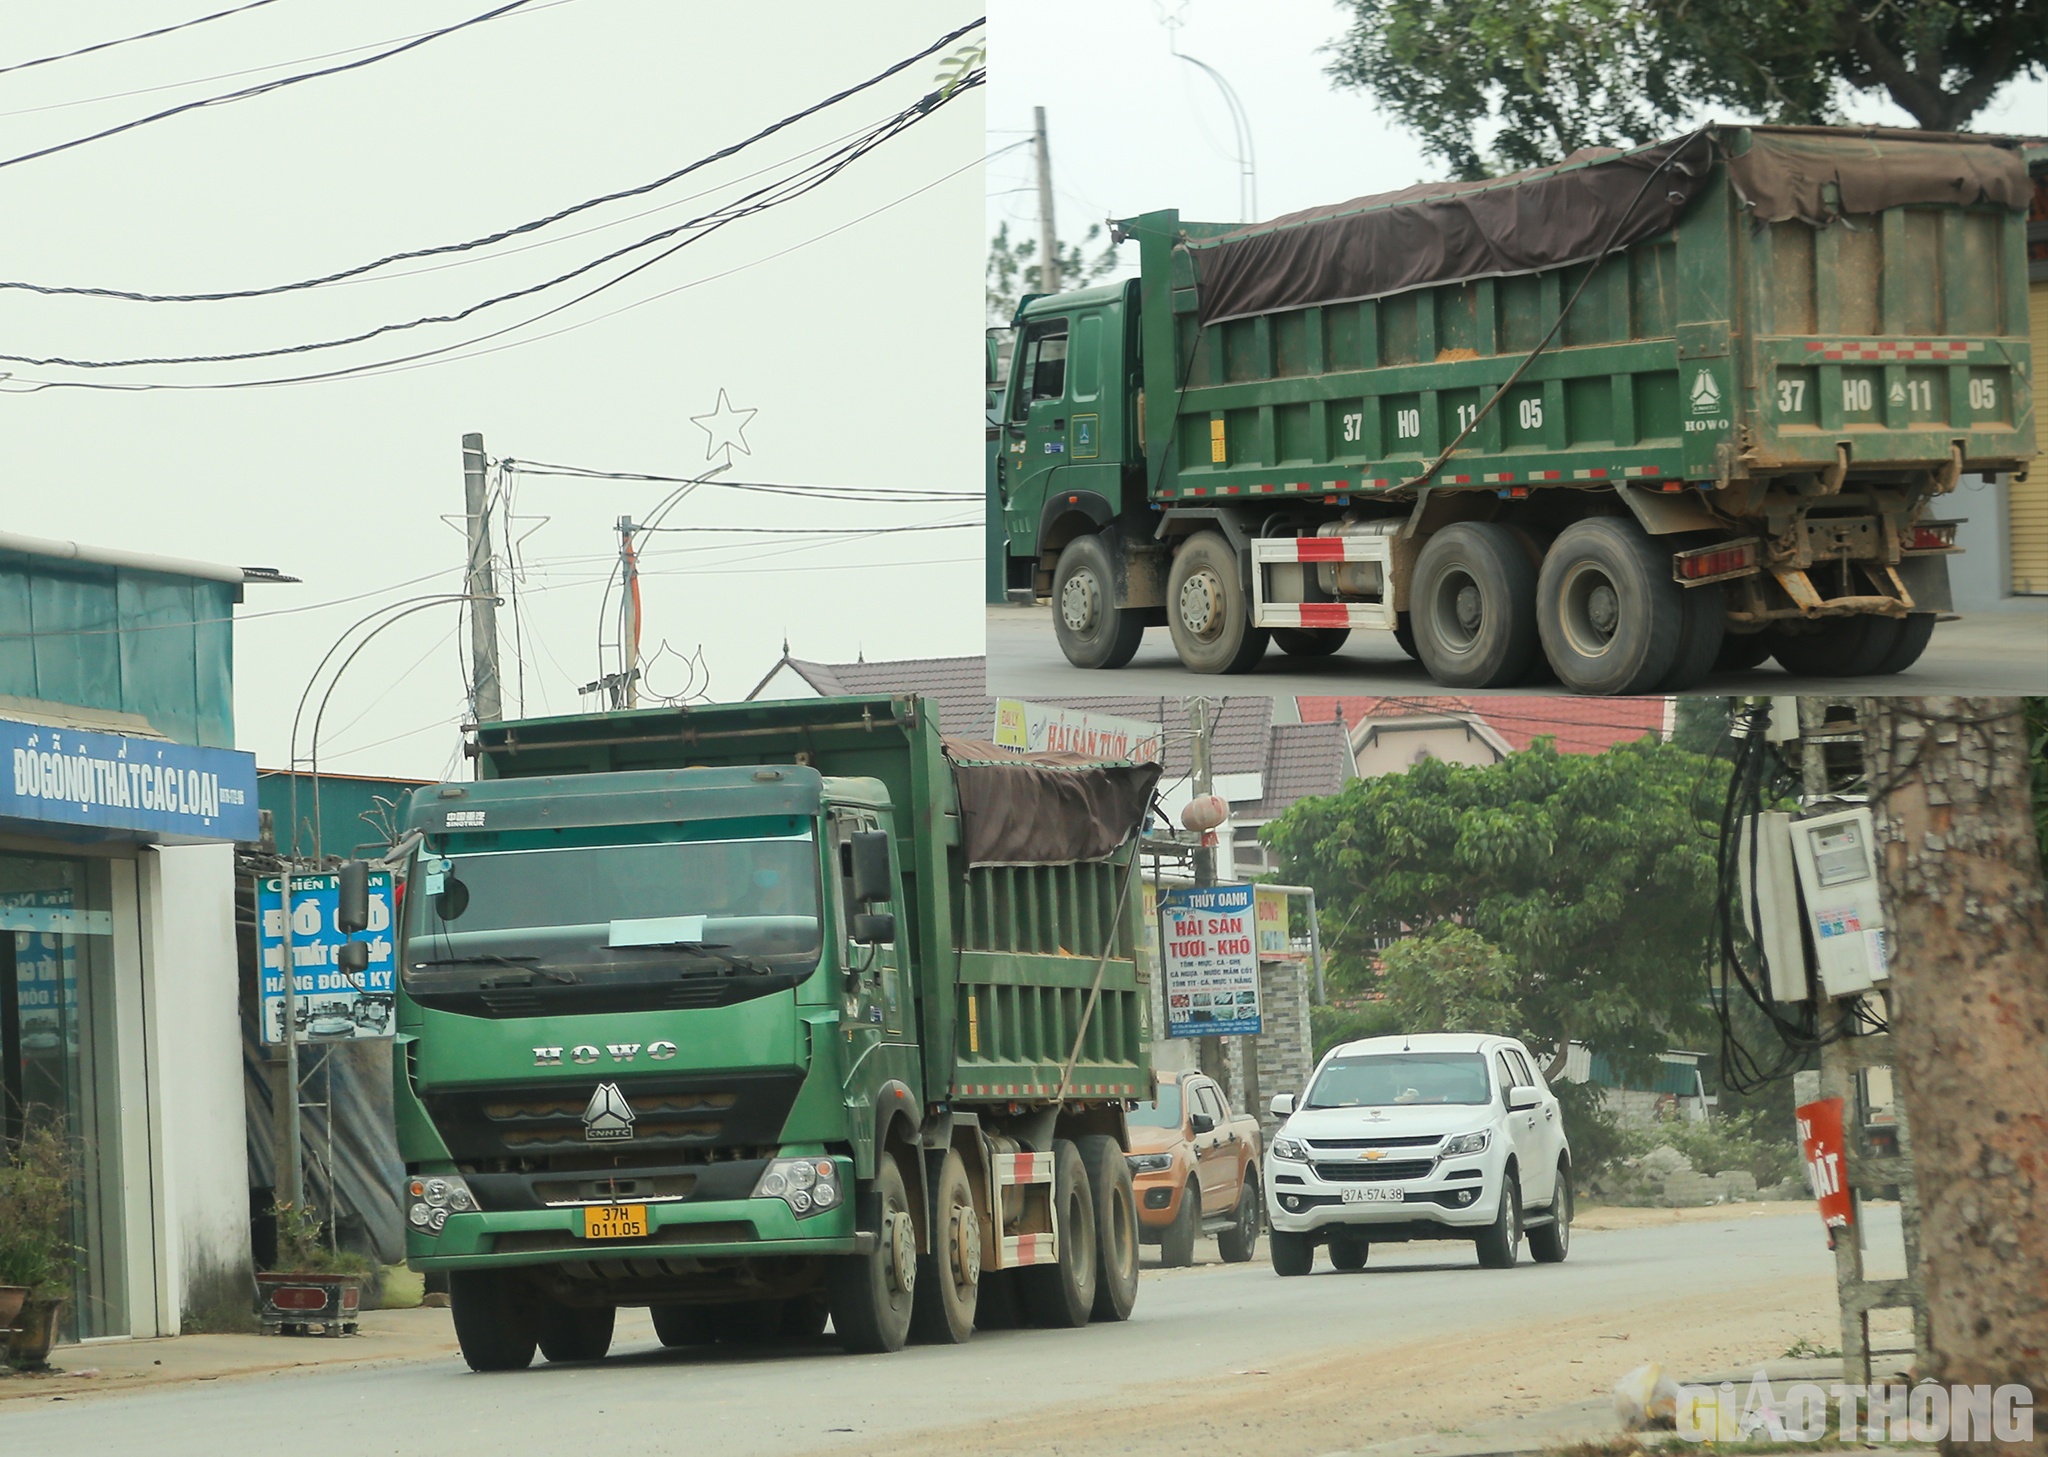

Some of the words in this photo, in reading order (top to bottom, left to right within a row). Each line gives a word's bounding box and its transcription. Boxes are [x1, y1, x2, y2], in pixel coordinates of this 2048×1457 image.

[1777, 380, 1805, 411] 37
[1908, 381, 1932, 411] 11
[1969, 379, 1995, 409] 05
[1343, 413, 1363, 441] 37
[1457, 404, 1477, 433] 11
[1519, 399, 1543, 429] 05
[1685, 419, 1729, 431] HOWO
[40, 734, 66, 800] GỖ
[65, 744, 96, 812] NỘI
[141, 751, 177, 813] CÁC
[178, 769, 220, 826] LOẠI
[1218, 891, 1248, 906] OANH
[1175, 915, 1203, 937] HẢI
[1208, 914, 1242, 935] SẢN
[1170, 940, 1206, 958] TƯƠI
[1218, 935, 1251, 955] KHÔ
[532, 1040, 678, 1066] HOWO
[588, 1129, 630, 1137] CNHTC
[602, 1207, 629, 1221] 37H
[592, 1221, 640, 1237] 011.05
